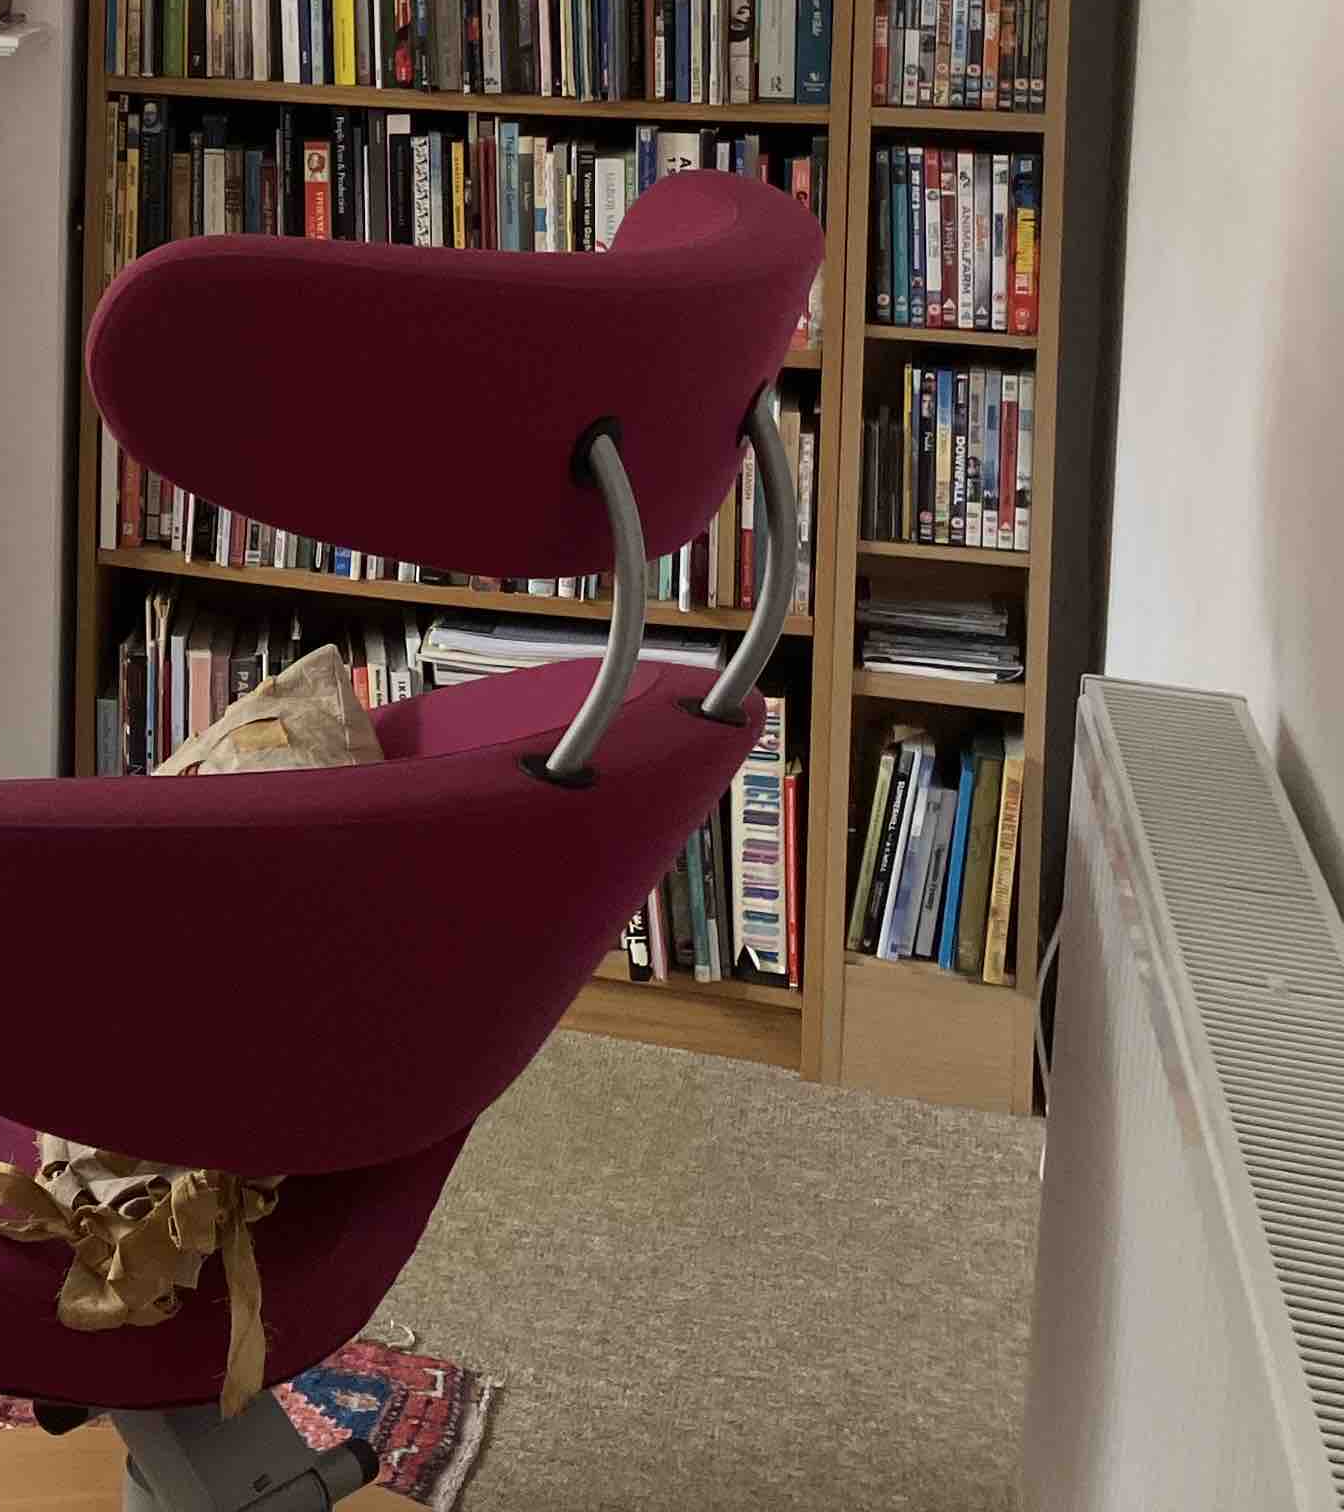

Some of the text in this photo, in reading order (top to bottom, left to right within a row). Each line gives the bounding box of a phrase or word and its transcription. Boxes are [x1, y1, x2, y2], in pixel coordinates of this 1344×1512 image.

[812, 11, 823, 37] Wilde
[582, 171, 592, 251] Vincent van Gogh
[961, 206, 972, 294] ANIMAL FARM
[953, 434, 966, 505] DOWNFALL
